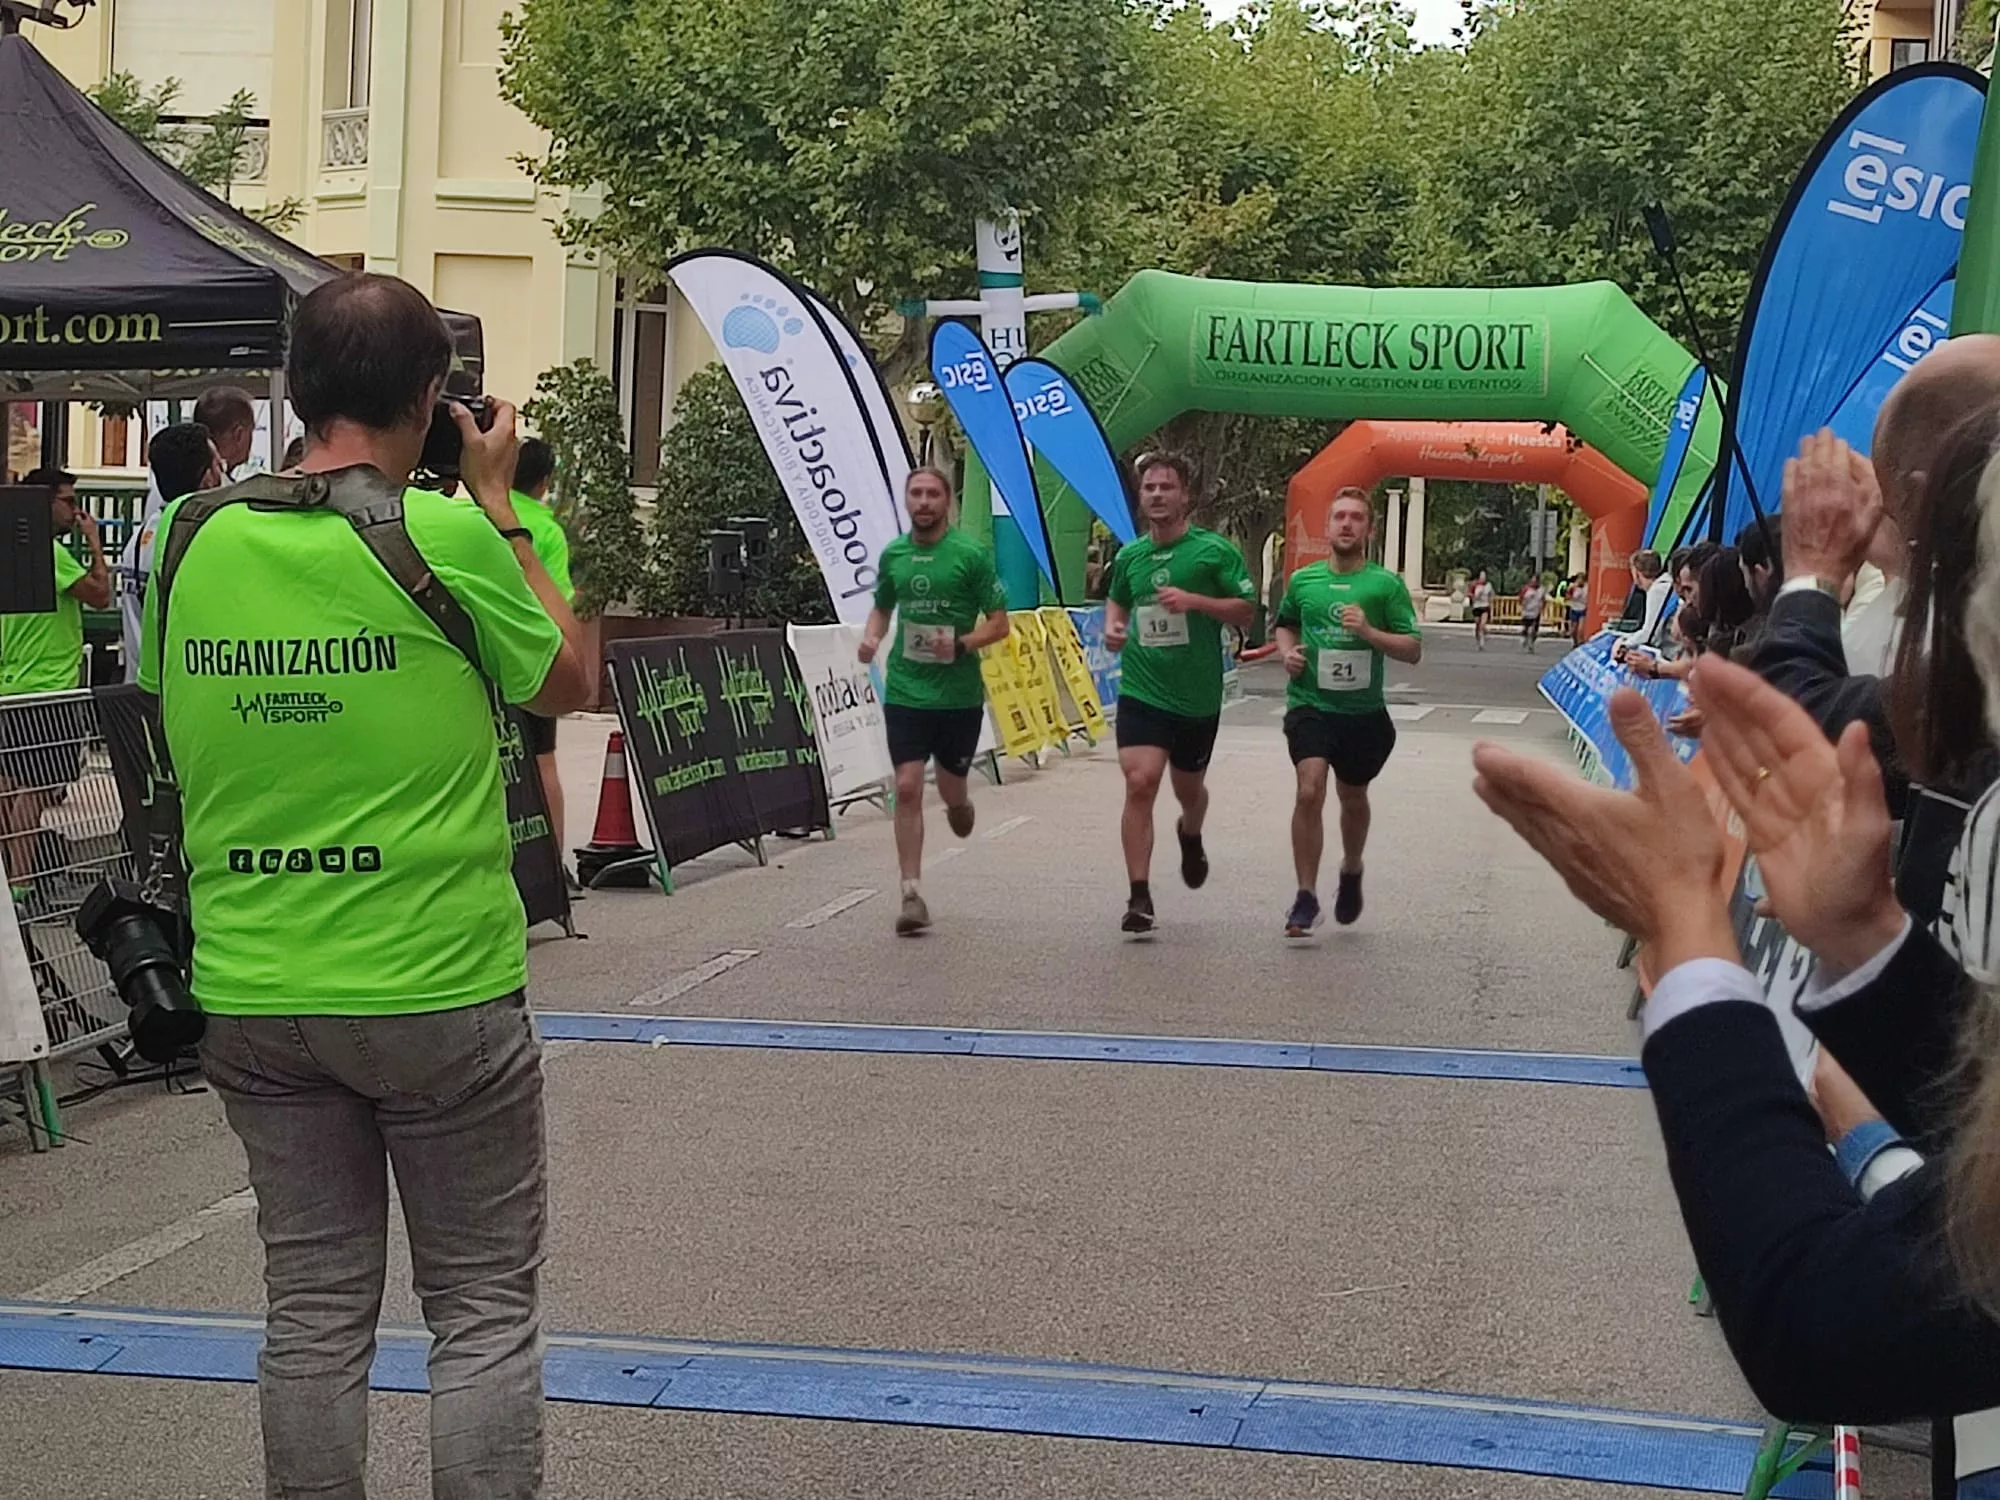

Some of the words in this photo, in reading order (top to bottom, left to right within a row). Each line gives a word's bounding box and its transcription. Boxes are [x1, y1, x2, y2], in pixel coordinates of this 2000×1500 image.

[1206, 315, 1398, 369] FARTLECK
[1408, 322, 1533, 371] SPORT
[1422, 379, 1444, 390] DE
[1448, 378, 1521, 391] EVENTOS
[1508, 433, 1561, 447] Huesca
[185, 627, 397, 676] ORGANIZACIÓN
[1332, 662, 1353, 677] 21
[264, 691, 328, 706] FARTLECK
[269, 710, 329, 724] SPORT
